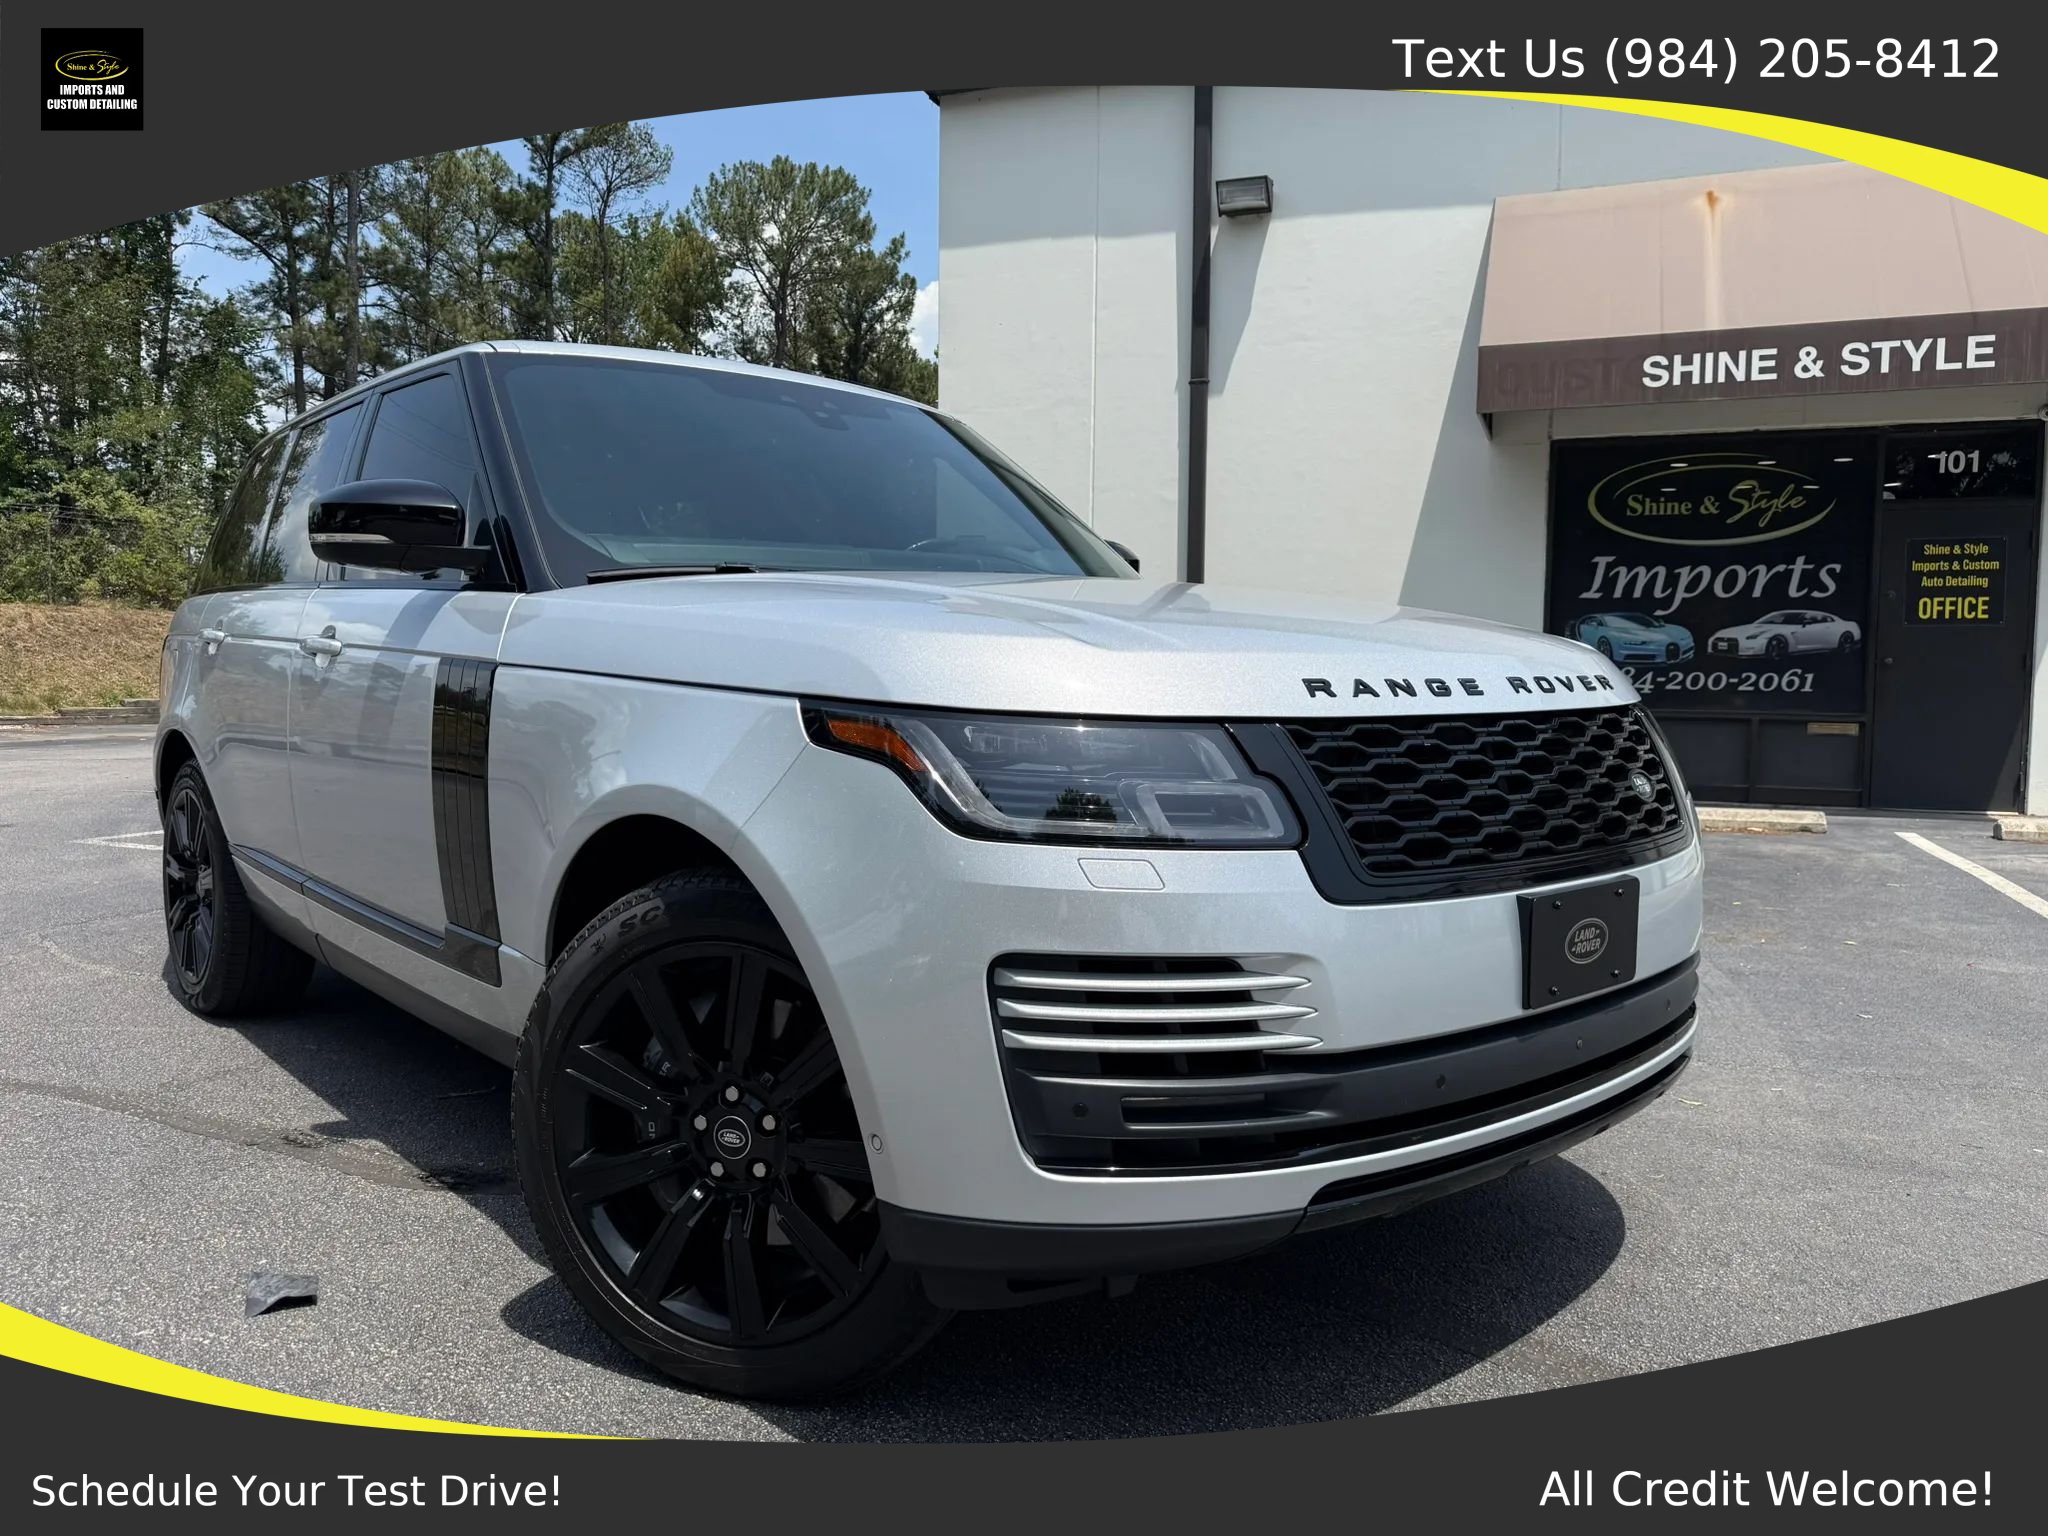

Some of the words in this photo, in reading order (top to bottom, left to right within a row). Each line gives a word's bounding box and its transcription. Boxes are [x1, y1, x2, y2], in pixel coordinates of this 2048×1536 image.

[1641, 347, 1779, 389] SHINE
[1793, 345, 1826, 379] &
[1839, 333, 1997, 376] STYLE
[1938, 450, 1979, 474] 101
[1626, 493, 1692, 517] Shine
[1699, 495, 1721, 515] &
[1725, 479, 1808, 528] Style
[1924, 544, 1950, 555] Shine
[1953, 545, 1961, 554] &
[1964, 543, 1989, 557] Style
[1912, 560, 1950, 573] Imports
[1952, 560, 1961, 571] &
[1963, 558, 2000, 570] Custom
[1578, 554, 1842, 617] Imports
[1921, 575, 1944, 587] Auto
[1945, 575, 1989, 588] Detailing
[1918, 596, 1990, 620] OFFICE
[1301, 677, 1485, 698] RANGE
[1506, 674, 1616, 695] ROVER
[1574, 927, 1596, 943] LAND
[1575, 938, 1601, 955] ROVER
